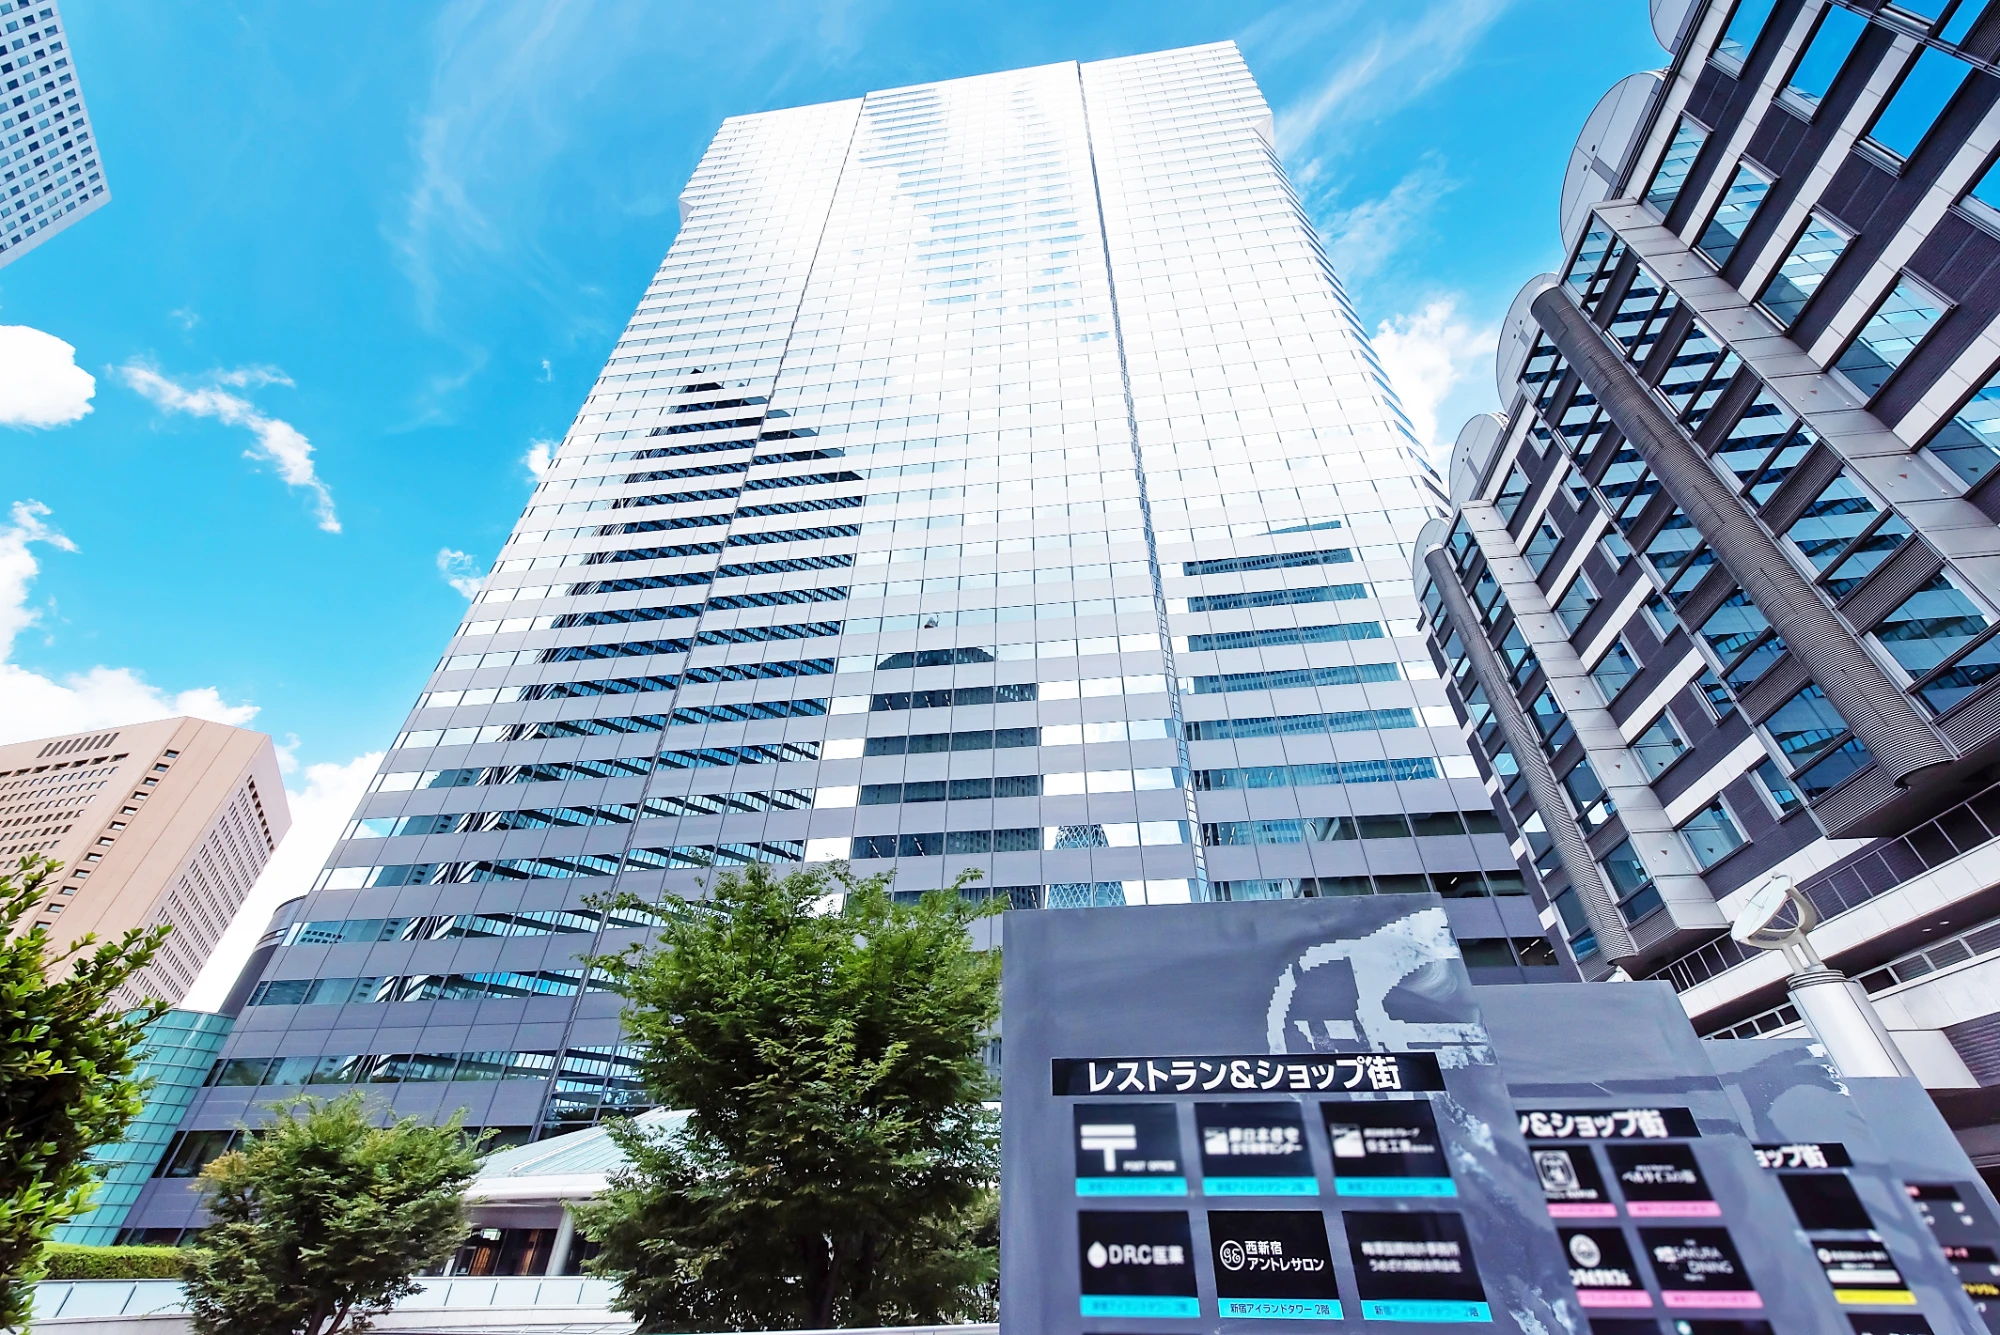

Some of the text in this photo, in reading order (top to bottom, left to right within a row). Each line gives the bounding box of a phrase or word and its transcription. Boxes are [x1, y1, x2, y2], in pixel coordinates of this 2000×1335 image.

[1088, 1056, 1401, 1092] レストラン&ショップ街
[1244, 1241, 1282, 1255] 西新宿
[1247, 1257, 1324, 1271] アントレサロン
[1230, 1303, 1331, 1315] 新宿アイランドタワー 2階
